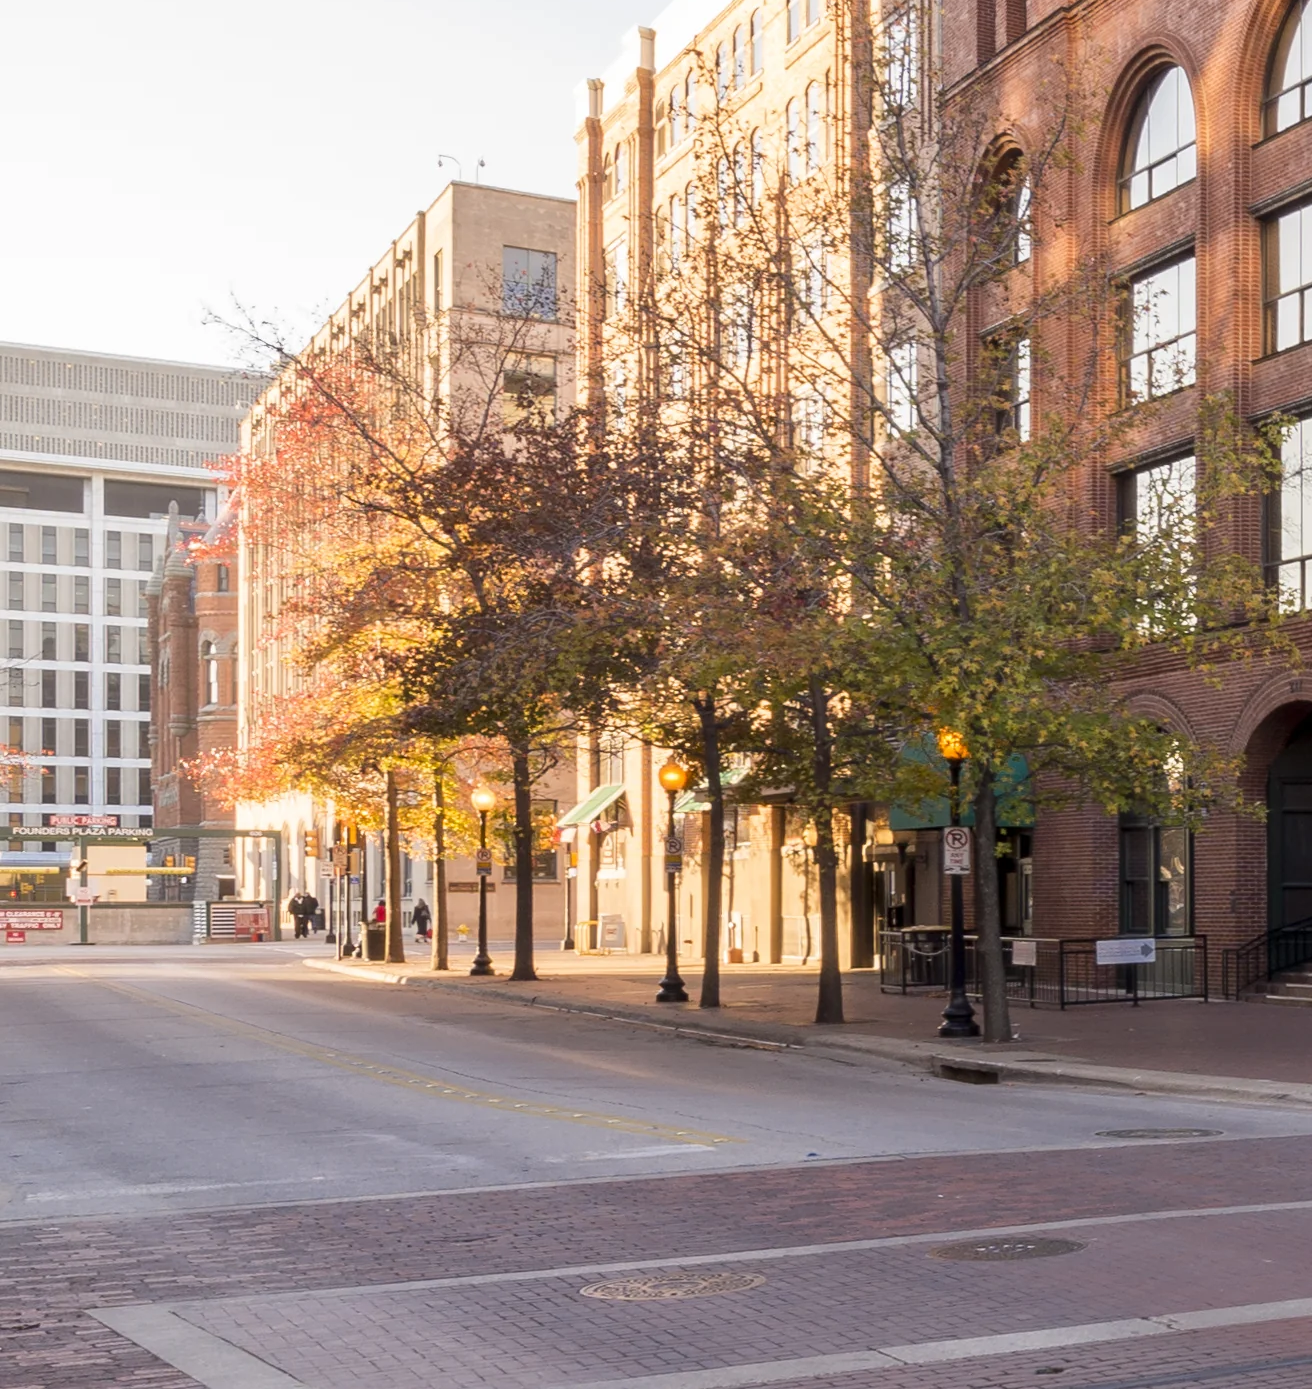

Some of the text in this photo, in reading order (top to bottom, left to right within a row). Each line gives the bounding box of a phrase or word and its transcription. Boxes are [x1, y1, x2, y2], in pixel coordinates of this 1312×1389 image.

[52, 816, 116, 826] PUBLIC PARKING
[13, 826, 153, 836] FOUNDERS PLAZA PARKING
